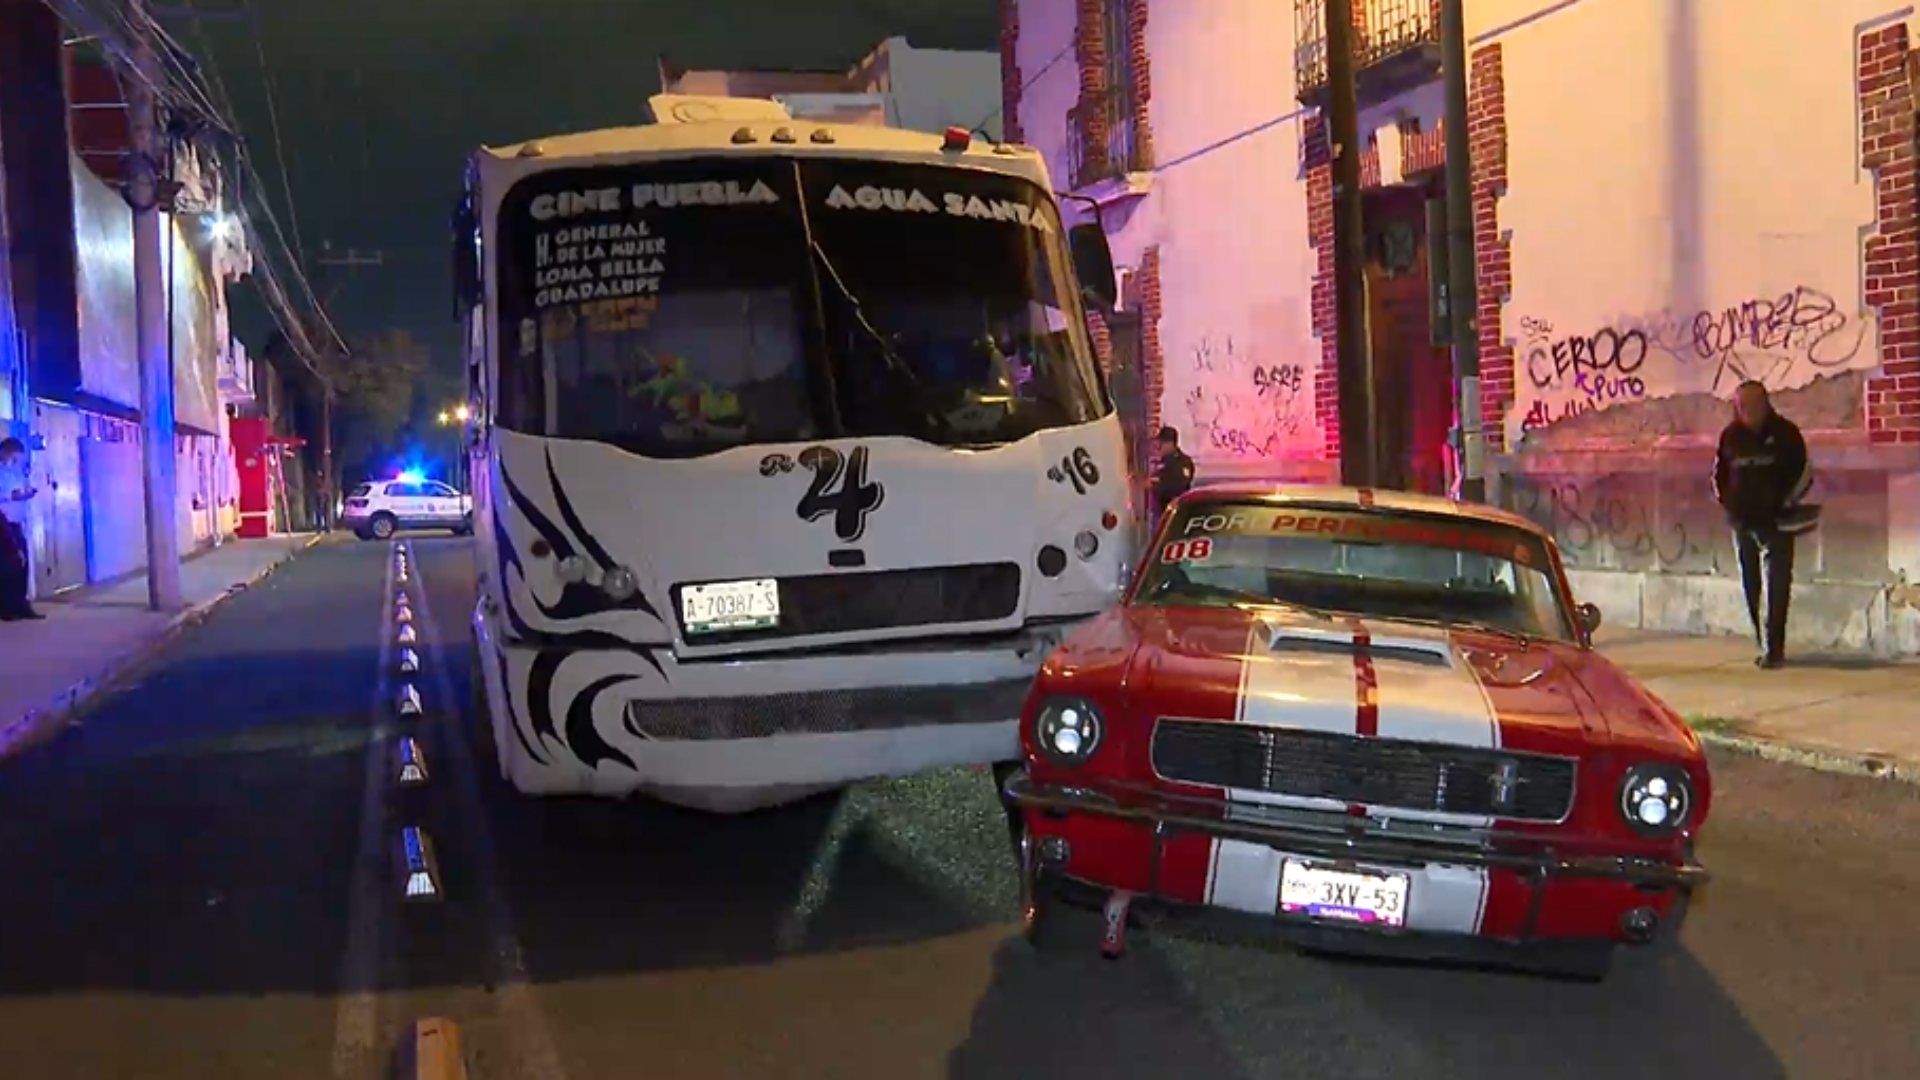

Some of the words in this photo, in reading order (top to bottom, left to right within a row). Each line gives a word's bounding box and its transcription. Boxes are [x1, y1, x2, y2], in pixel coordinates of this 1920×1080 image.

[530, 187, 621, 220] CINE
[632, 178, 780, 208] PUEBLA
[825, 184, 940, 213] AGUA
[943, 192, 1054, 233] SANTA
[555, 221, 649, 246] GENERAL
[557, 247, 578, 264] DE
[583, 245, 606, 261] LA
[611, 238, 666, 258] MUJER
[535, 264, 594, 288] LOMA
[601, 258, 665, 279] BELLA
[535, 277, 660, 308] GUADALUPE
[1528, 327, 1648, 388] CERDO
[1594, 374, 1645, 402] PUTO
[1062, 446, 1100, 495] 16
[796, 446, 885, 543] 24
[1184, 514, 1259, 534] FOR
[1161, 536, 1213, 564] 08
